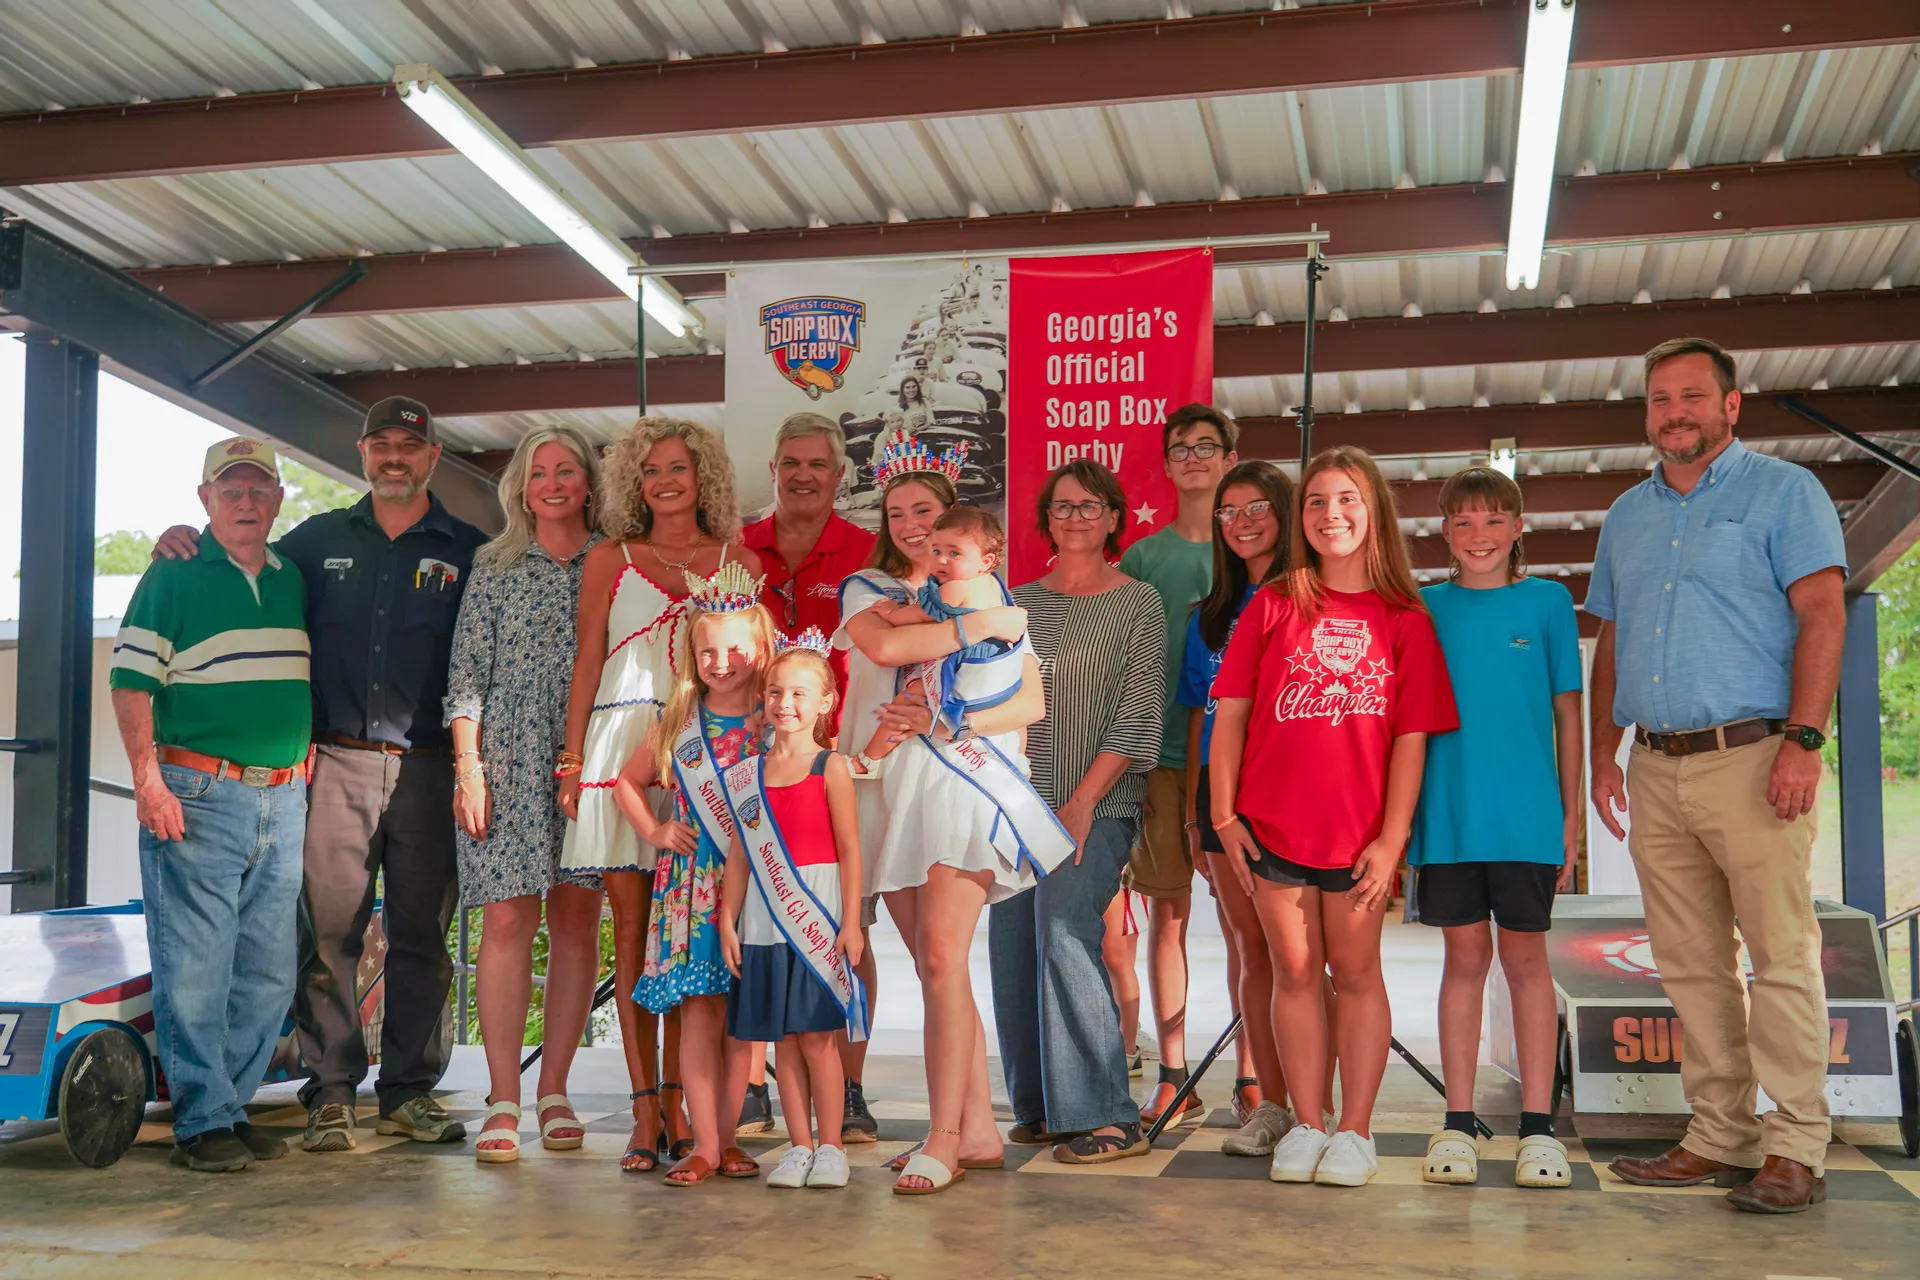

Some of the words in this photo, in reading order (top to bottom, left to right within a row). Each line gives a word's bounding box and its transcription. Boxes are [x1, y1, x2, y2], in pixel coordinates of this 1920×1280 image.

[763, 301, 818, 318] SOUTHEAST
[820, 301, 862, 315] GEORGIA
[770, 316, 816, 346] SOAP
[817, 315, 854, 345] BOX
[1047, 307, 1178, 343] Georgia's
[789, 341, 836, 360] DERBY
[1047, 351, 1145, 385] Official
[1046, 398, 1110, 431] Soap
[1120, 395, 1168, 425] Box
[1317, 635, 1343, 648] SOAP
[1344, 636, 1366, 652] BOX
[955, 739, 987, 772] Derby
[726, 766, 757, 788] LITTLE
[729, 761, 752, 777] 2024
[732, 777, 753, 794] MISS
[759, 841, 793, 903] Southeast
[787, 899, 810, 925] GA
[802, 921, 828, 954] Soap
